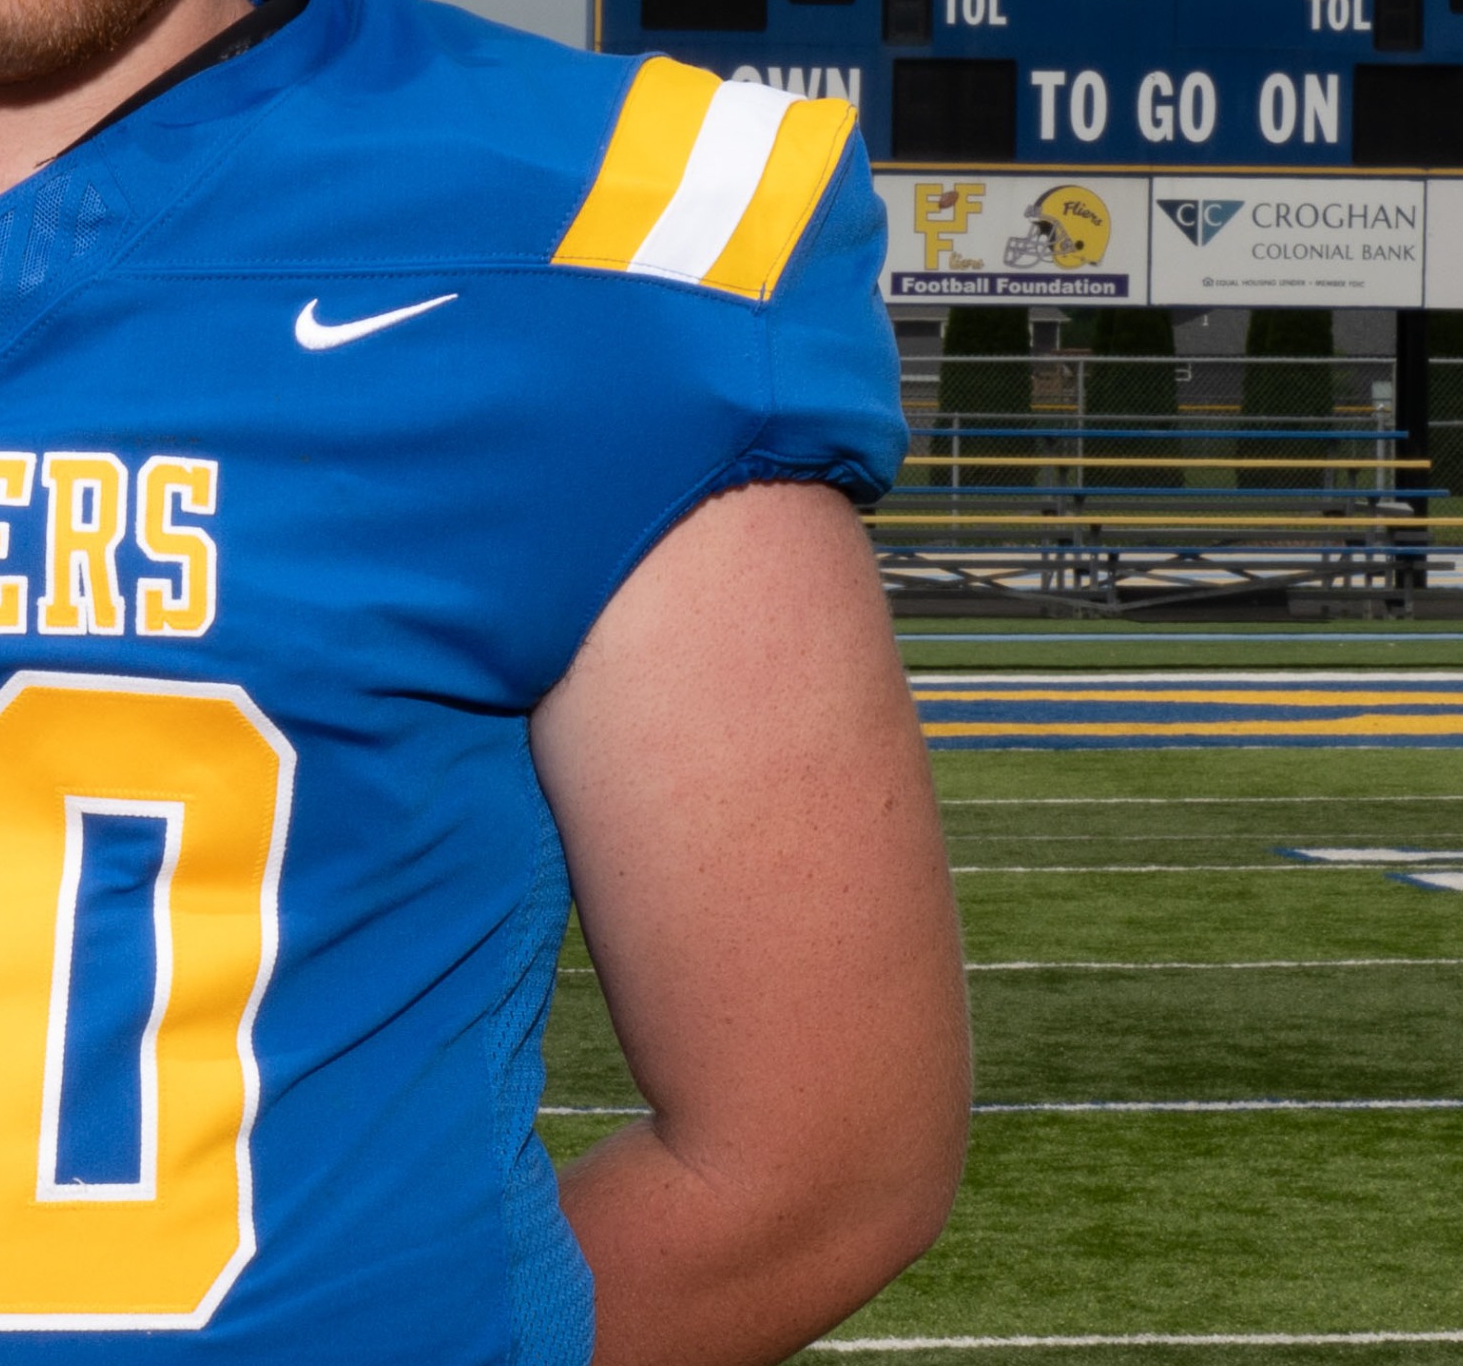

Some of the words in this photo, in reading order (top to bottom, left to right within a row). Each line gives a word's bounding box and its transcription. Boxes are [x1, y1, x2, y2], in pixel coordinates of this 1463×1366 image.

[1031, 70, 1108, 142] TO
[1138, 71, 1217, 143] GO
[1259, 73, 1339, 144] ON
[1062, 200, 1104, 227] Fliers
[1251, 202, 1417, 230] CROGHAN
[1251, 243, 1354, 261] COLONIAL
[1361, 244, 1417, 262] BANK
[901, 277, 988, 294] Football
[996, 278, 1116, 295] Foundation
